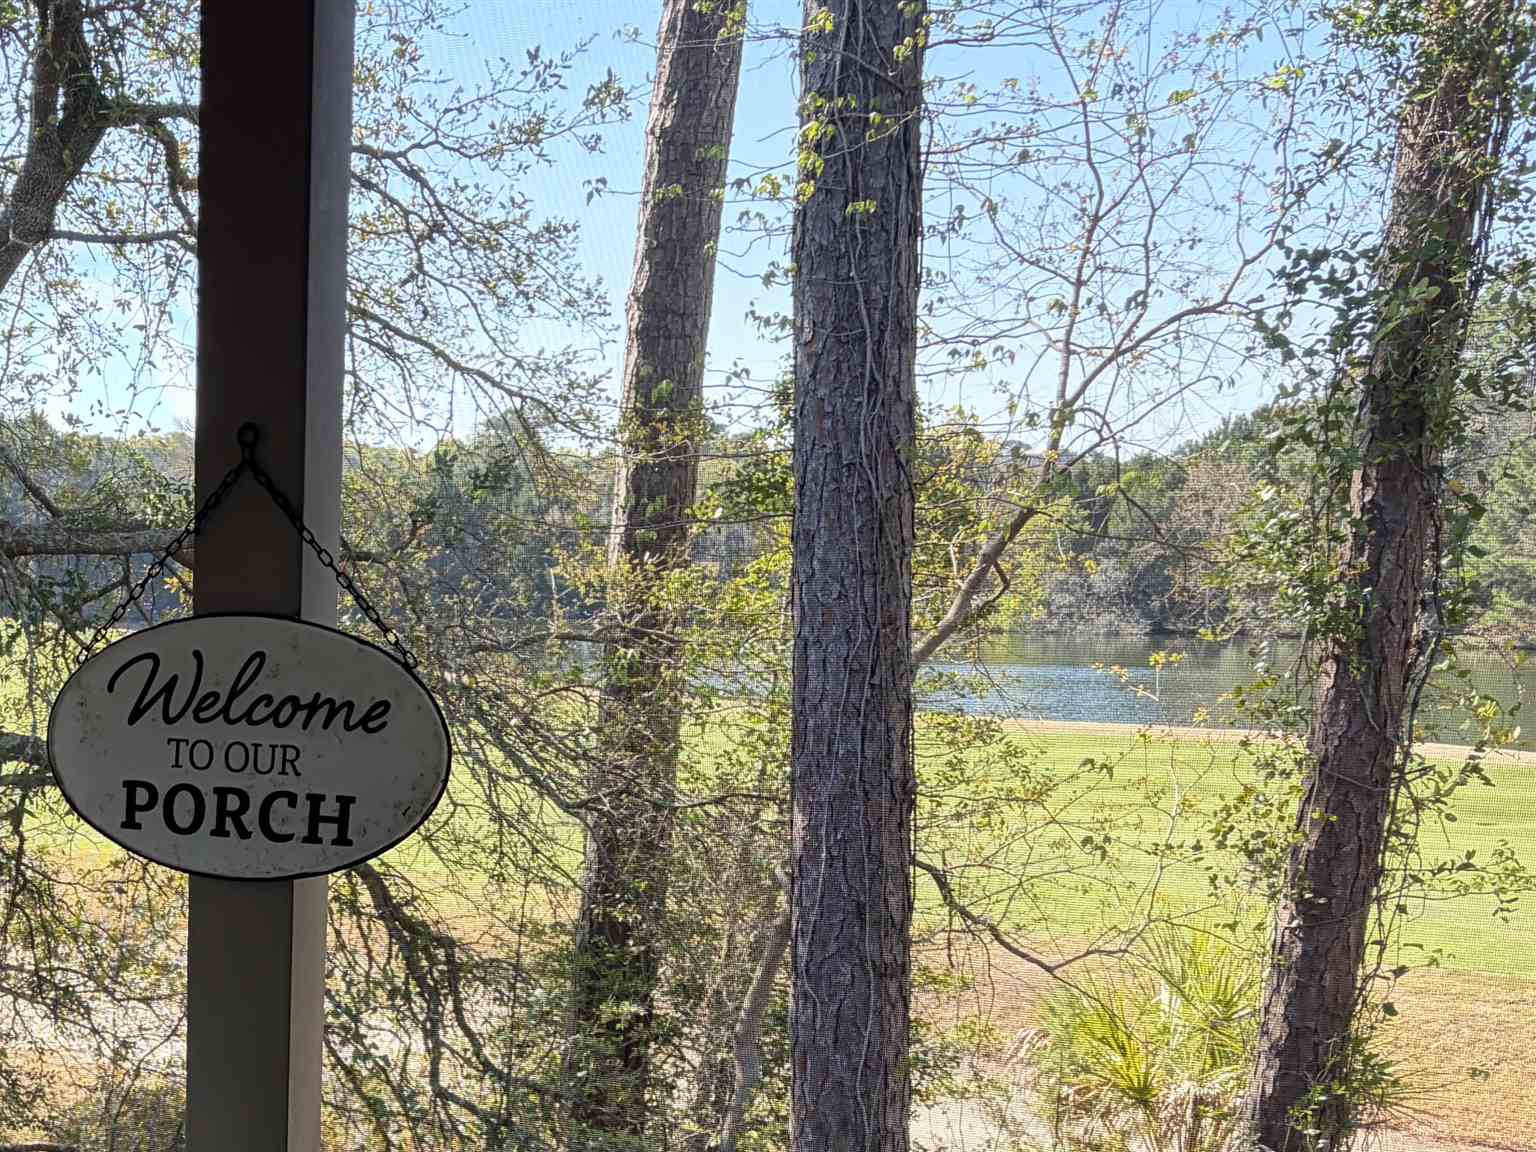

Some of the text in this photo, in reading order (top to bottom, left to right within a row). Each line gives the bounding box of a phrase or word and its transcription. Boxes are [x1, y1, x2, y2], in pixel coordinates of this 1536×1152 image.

[107, 648, 392, 735] Welcome
[167, 738, 302, 777] TO OUR
[120, 779, 357, 848] PORCH
